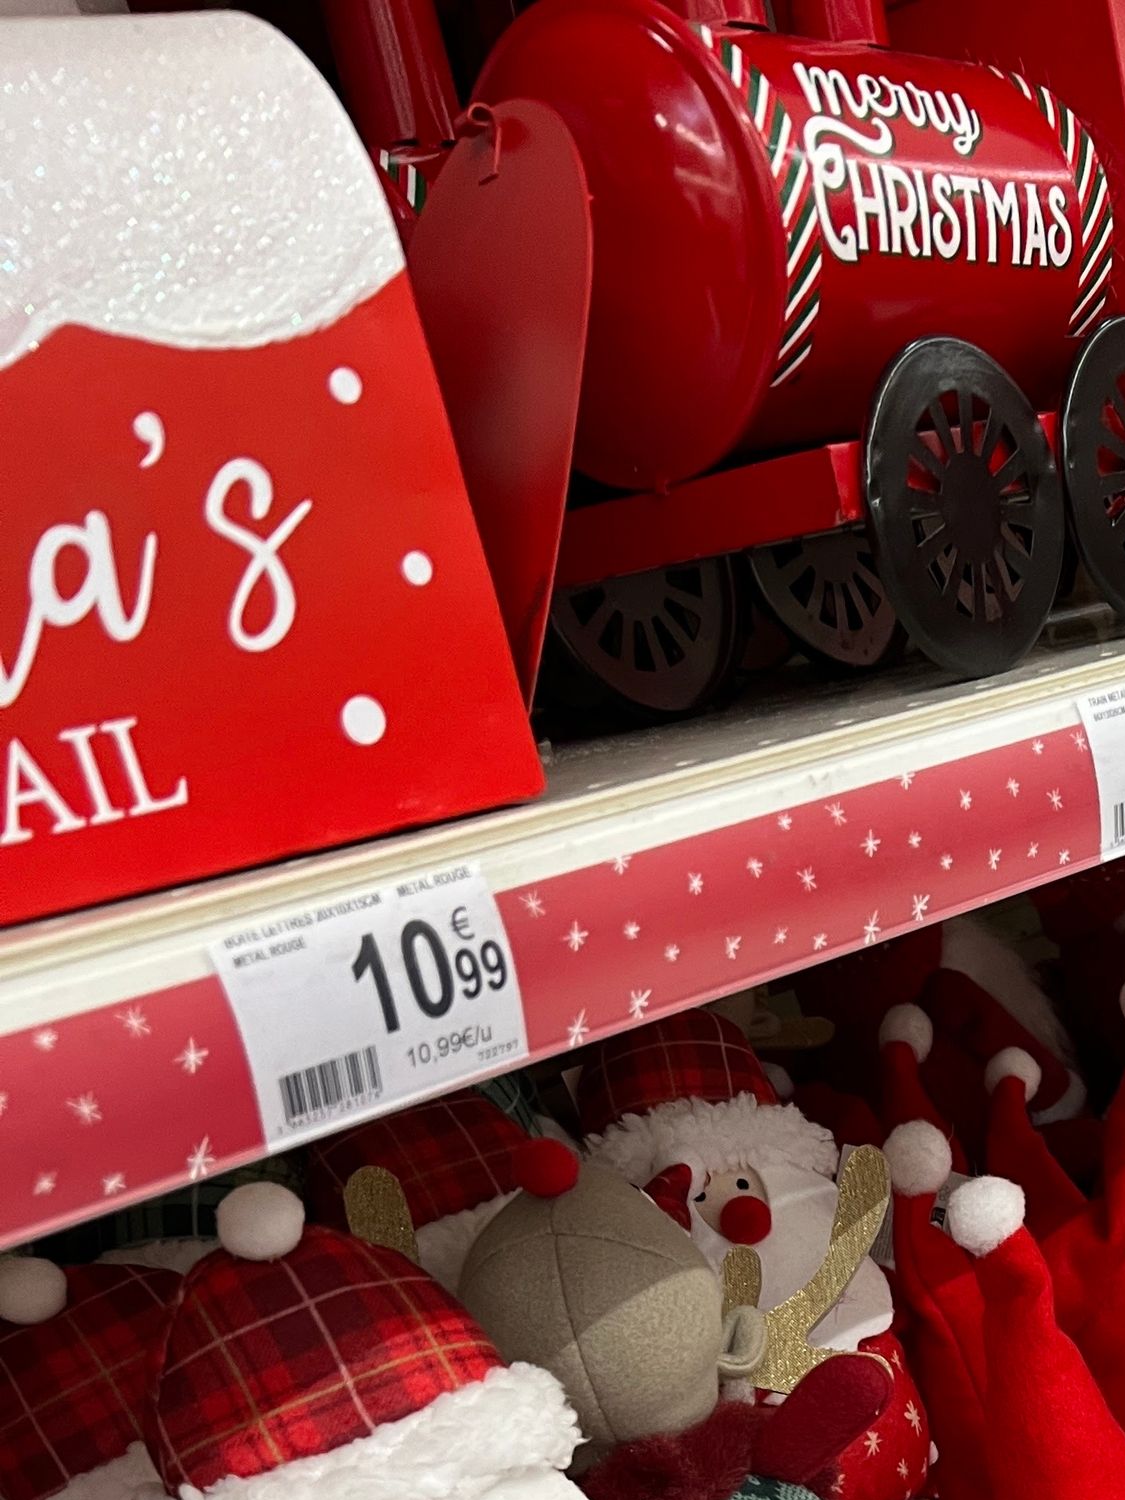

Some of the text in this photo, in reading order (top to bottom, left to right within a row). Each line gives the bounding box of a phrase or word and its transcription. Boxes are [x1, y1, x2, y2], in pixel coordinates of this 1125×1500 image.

[792, 62, 983, 155] merry
[803, 115, 1073, 268] CHRISTMAS
[0, 716, 190, 847] AIL
[406, 1024, 493, 1069] 10,99€/u
